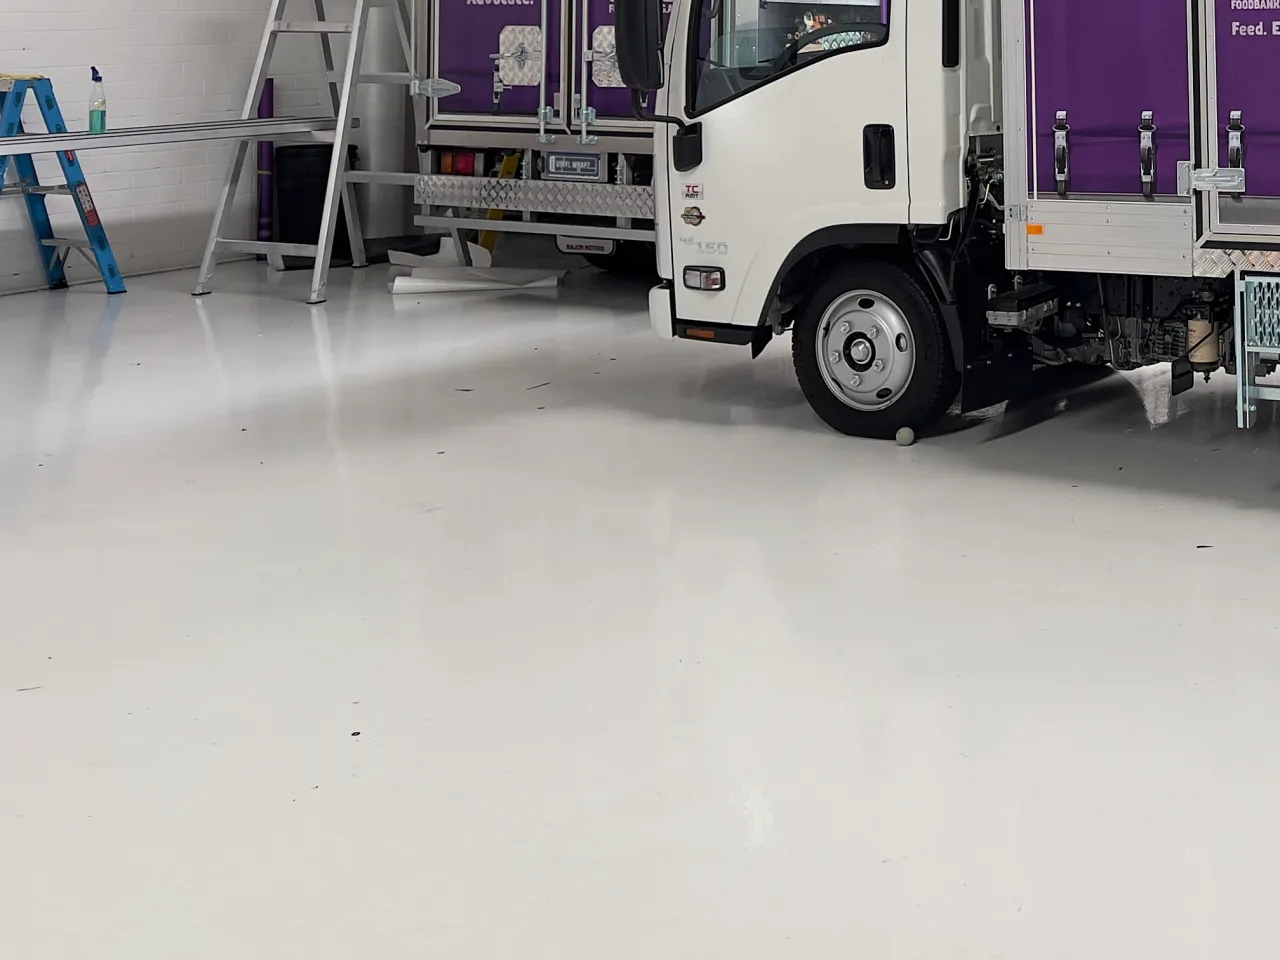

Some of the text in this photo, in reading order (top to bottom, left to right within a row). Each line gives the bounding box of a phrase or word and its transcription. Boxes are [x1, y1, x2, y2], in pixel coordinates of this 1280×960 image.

[1231, 21, 1267, 36] Feed.
[556, 160, 571, 168] VINYL
[572, 160, 591, 170] WRAPZ
[685, 185, 699, 193] TC
